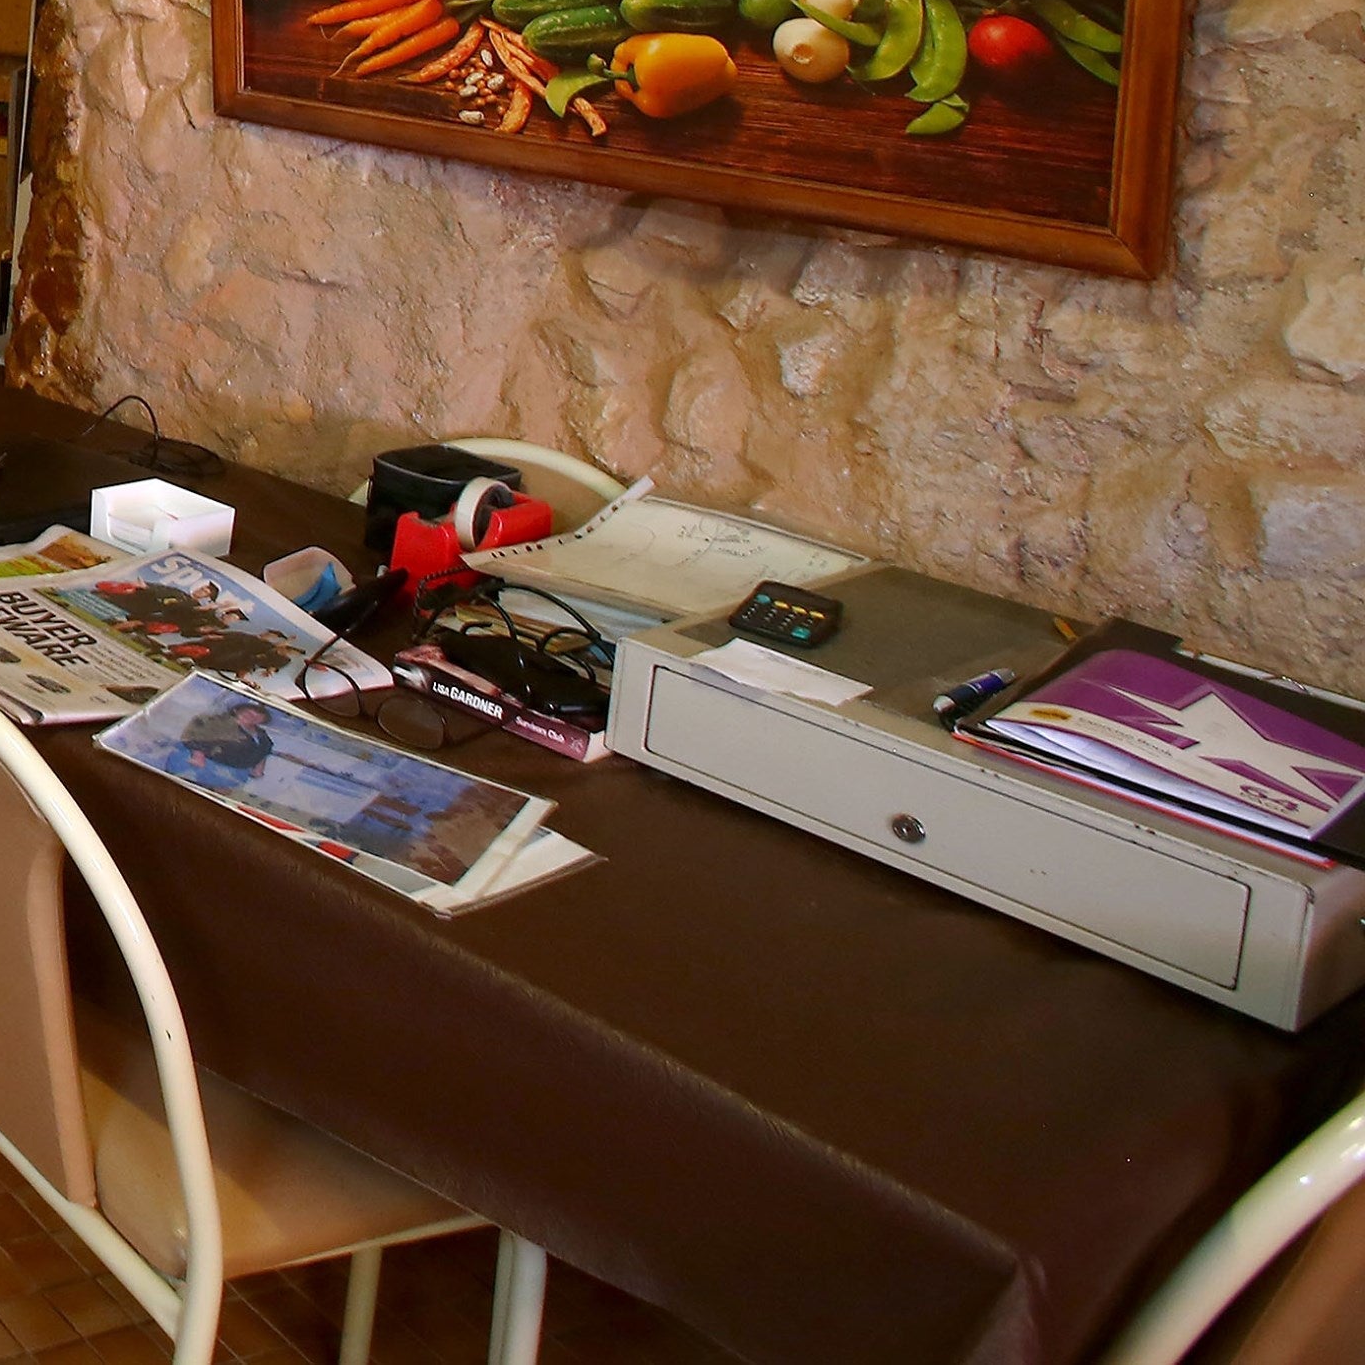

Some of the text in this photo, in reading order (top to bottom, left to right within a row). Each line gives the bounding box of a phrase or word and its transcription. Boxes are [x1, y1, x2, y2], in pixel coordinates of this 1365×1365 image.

[432, 681, 504, 721] LISA GARDNER
[547, 728, 565, 743] Club
[1239, 784, 1299, 812] 64
